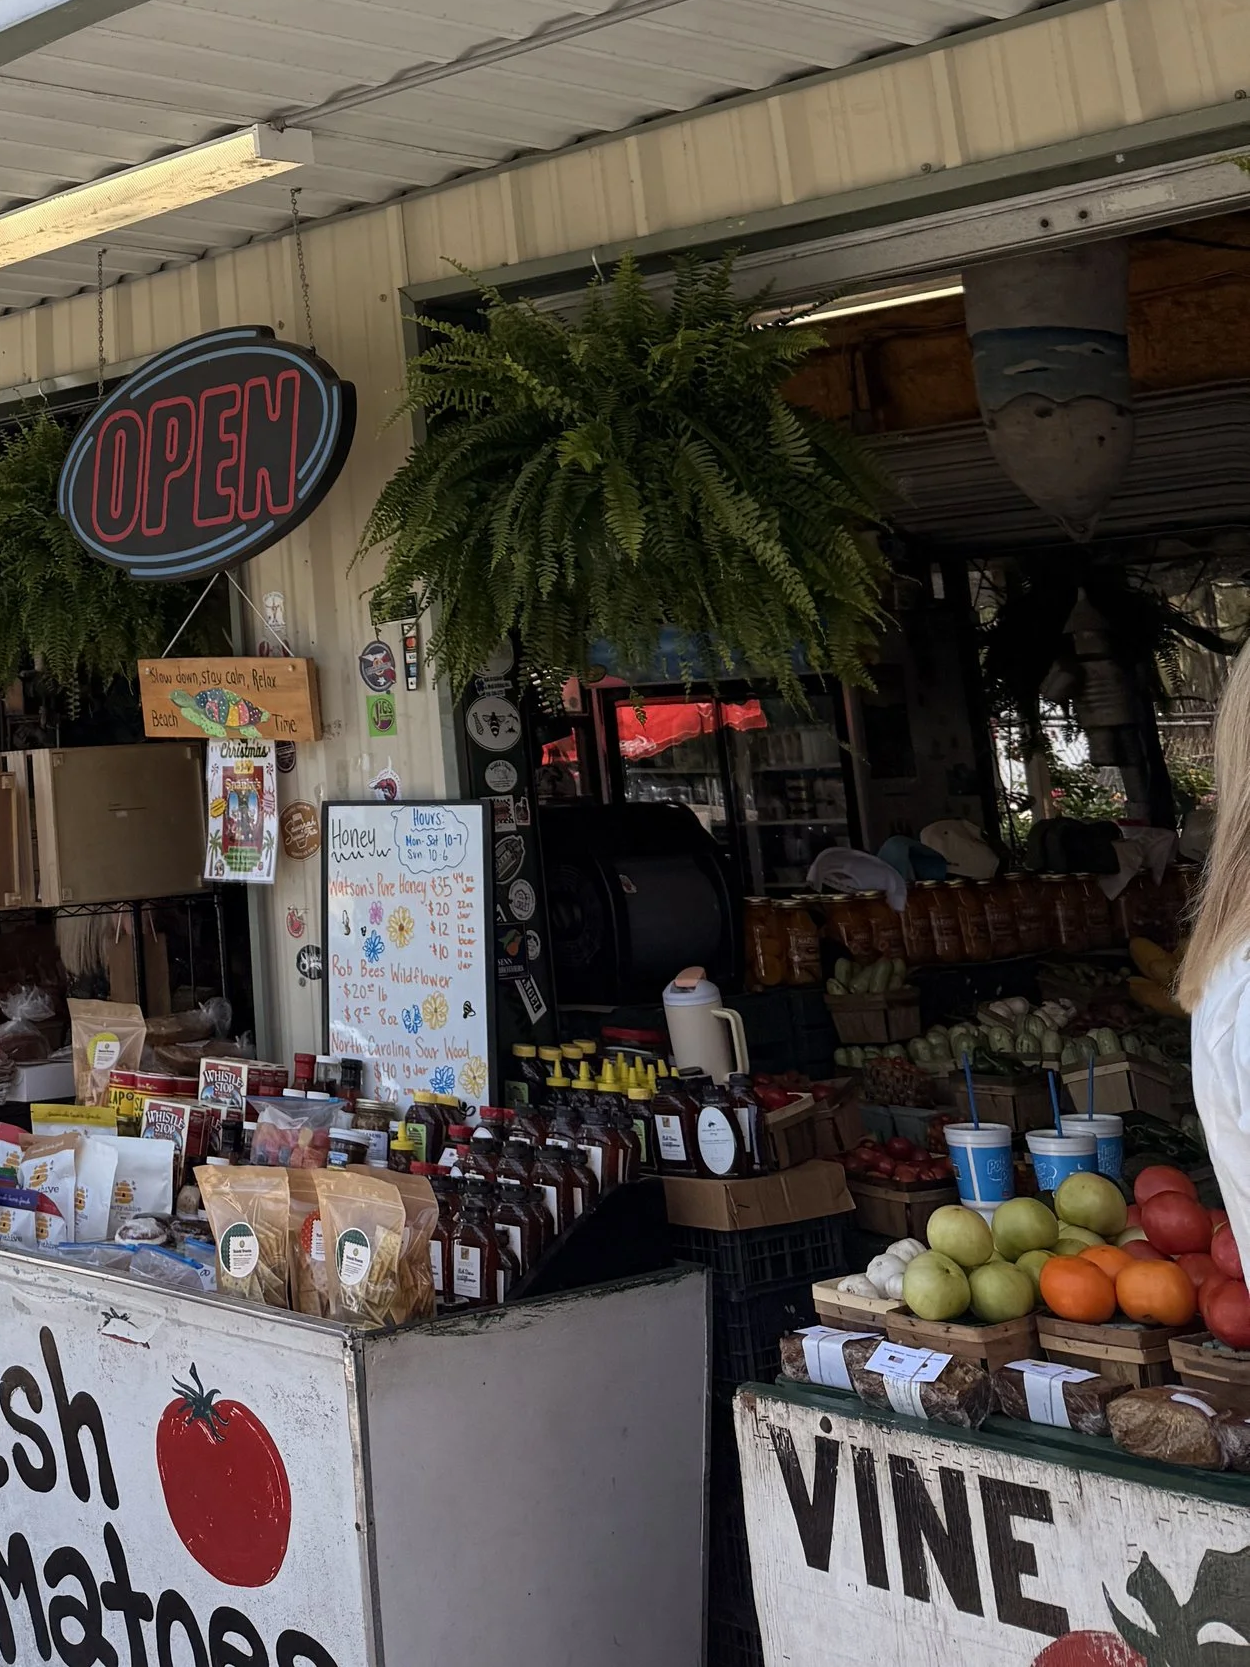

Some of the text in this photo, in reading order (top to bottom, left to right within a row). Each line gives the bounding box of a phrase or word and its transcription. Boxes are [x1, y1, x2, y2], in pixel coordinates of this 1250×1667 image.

[91, 368, 301, 543] OPEN
[150, 667, 172, 684] Slow
[252, 669, 276, 691] Relax
[152, 710, 178, 728] Beach
[272, 713, 297, 733] Time
[220, 741, 269, 758] Christmas
[331, 818, 375, 856] Honey
[407, 848, 423, 860] Sun
[329, 871, 374, 899] Watson's
[377, 872, 396, 897] Pure
[399, 872, 426, 905] Honey
[430, 875, 452, 898] $35
[428, 900, 450, 917] $20
[430, 920, 449, 936] $12
[431, 944, 449, 960] $10
[360, 958, 385, 978] Bees
[390, 962, 454, 988] Wildflower
[331, 1032, 363, 1054] North
[367, 1035, 411, 1059] Carolina
[443, 1036, 470, 1060] Wood
[203, 1069, 244, 1088] WHISTLE
[214, 1082, 234, 1094] STOP
[145, 1109, 186, 1129] WHISTLE
[154, 1122, 176, 1134] STOP
[767, 1425, 1070, 1639] VINE
